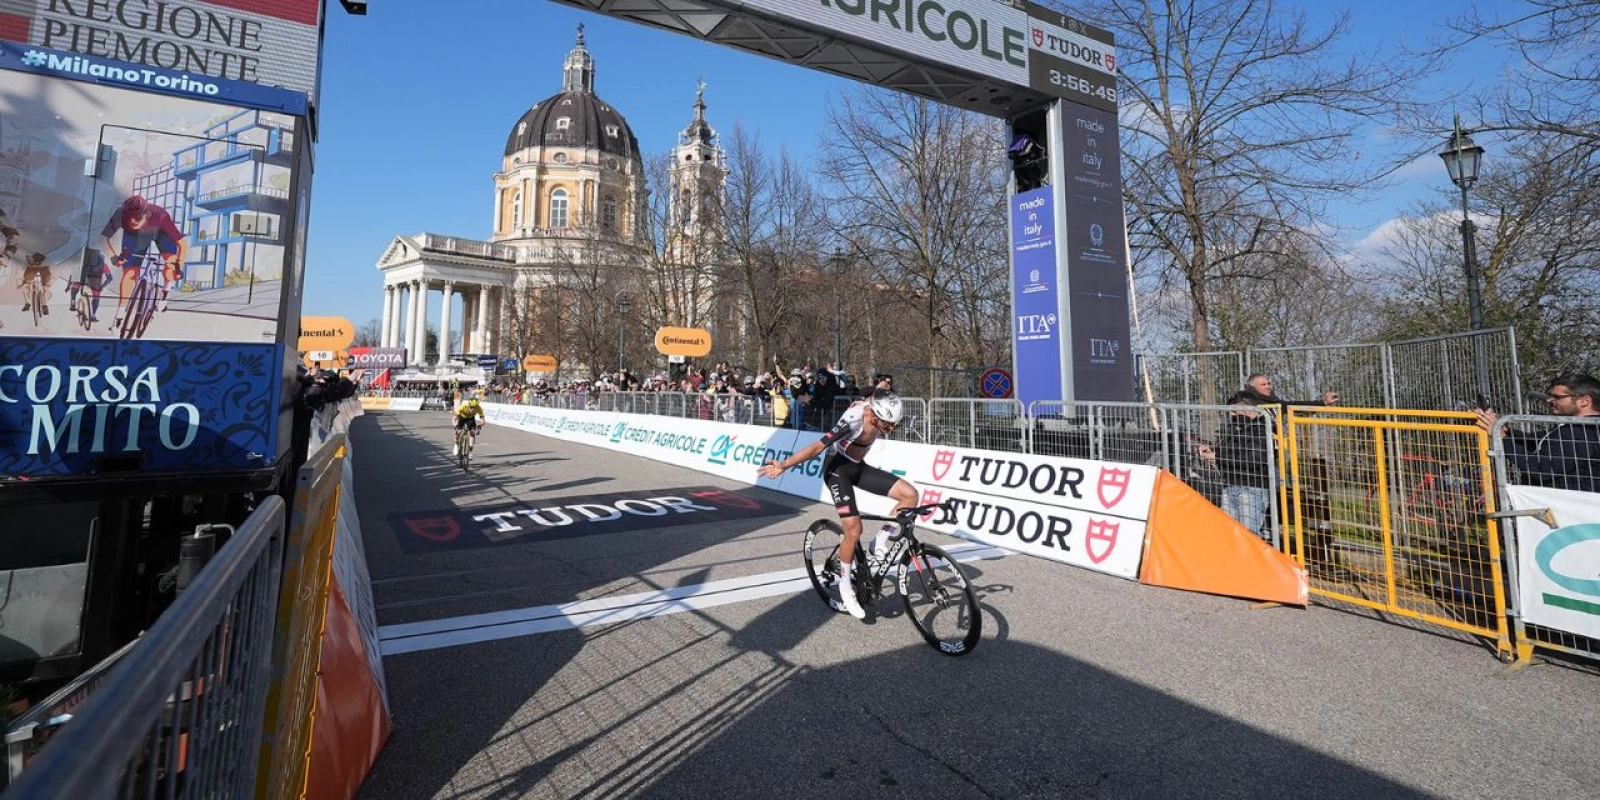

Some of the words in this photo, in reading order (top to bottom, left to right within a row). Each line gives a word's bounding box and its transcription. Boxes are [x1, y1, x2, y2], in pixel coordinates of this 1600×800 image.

[40, 18, 260, 84] PIEMONTE
[1047, 34, 1102, 66] TUDOR
[21, 50, 219, 95] #MilanoTorino
[1049, 69, 1117, 102] 3:56:49
[1076, 118, 1105, 133] made
[1087, 134, 1096, 147] in
[1082, 150, 1102, 170] italy
[1020, 197, 1045, 211] made
[1028, 212, 1037, 221] in
[1024, 223, 1042, 236] italy
[1018, 314, 1050, 334] ITA
[1090, 338, 1115, 357] ITA
[354, 354, 402, 364] TOYOTA
[0, 365, 161, 403] CORSA
[26, 402, 200, 456] MITO
[654, 432, 707, 454] AGRICOLE
[959, 455, 1085, 499] TUDOR
[473, 497, 718, 532] TUDOR
[947, 497, 1072, 552] TUDOR
